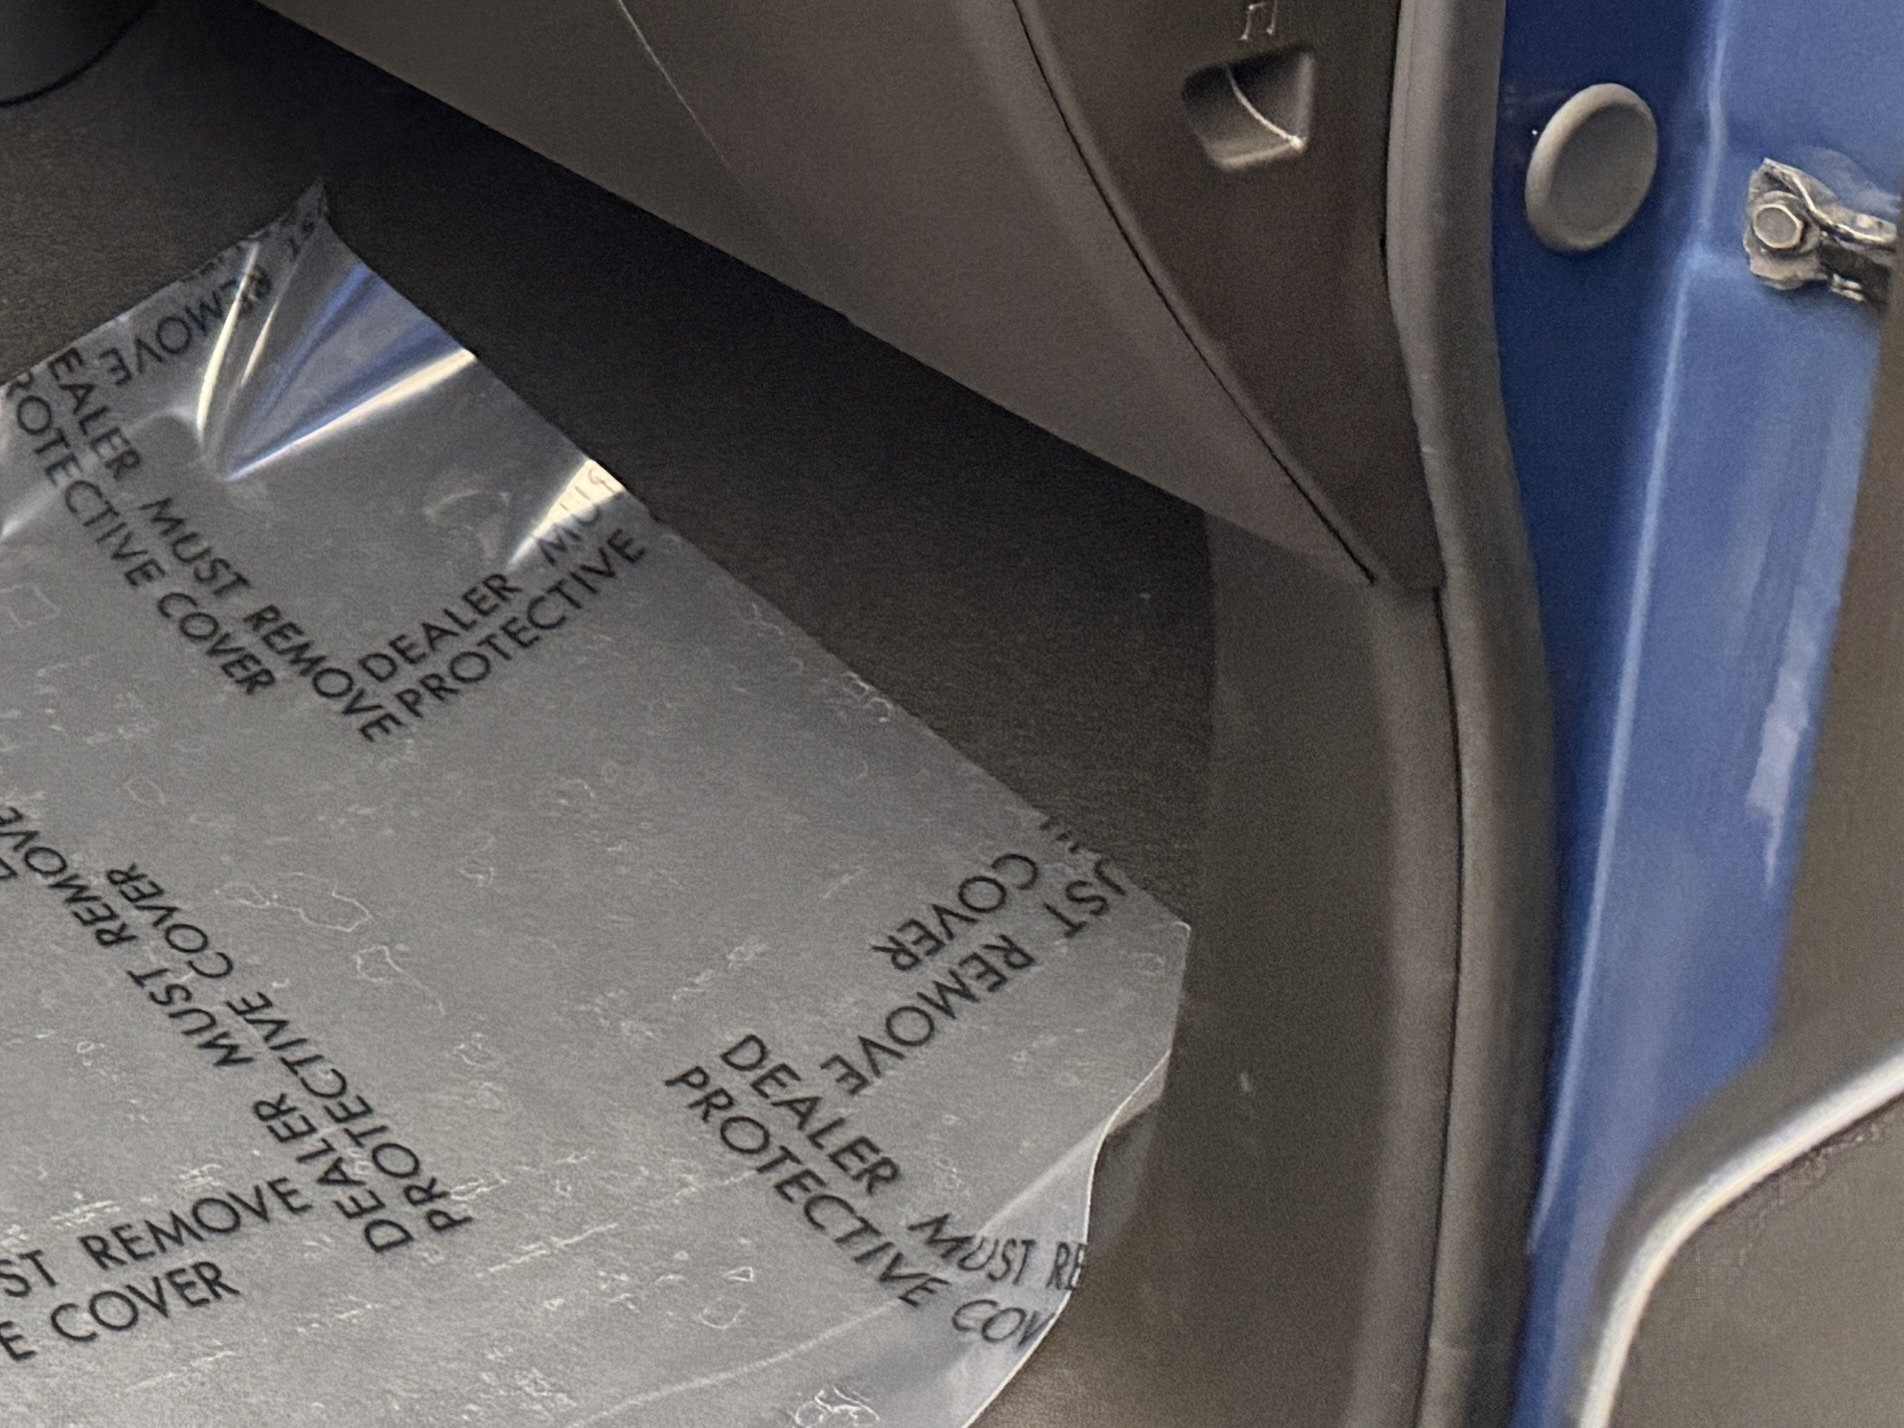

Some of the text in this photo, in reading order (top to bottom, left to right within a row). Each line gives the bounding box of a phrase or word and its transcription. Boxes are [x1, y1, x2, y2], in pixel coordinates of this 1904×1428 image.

[4, 371, 280, 697] ROTECTIVE COVER
[46, 346, 403, 744] EALER MUST REMOVE
[358, 572, 522, 683] DEALER
[397, 527, 650, 721] PROTECTIVE
[872, 852, 1040, 972] COVER
[105, 863, 472, 1234] PROTECTIVE COVER
[128, 966, 257, 1068] MUST
[818, 935, 1034, 1095] REMOVE
[81, 1176, 313, 1272] REMOVE
[253, 1093, 415, 1253] DEALER
[664, 1064, 1060, 1347] PROTECTIVE COV
[720, 1033, 901, 1194] DEALER
[910, 1213, 1034, 1286] MUST
[51, 1261, 241, 1342] COVER
